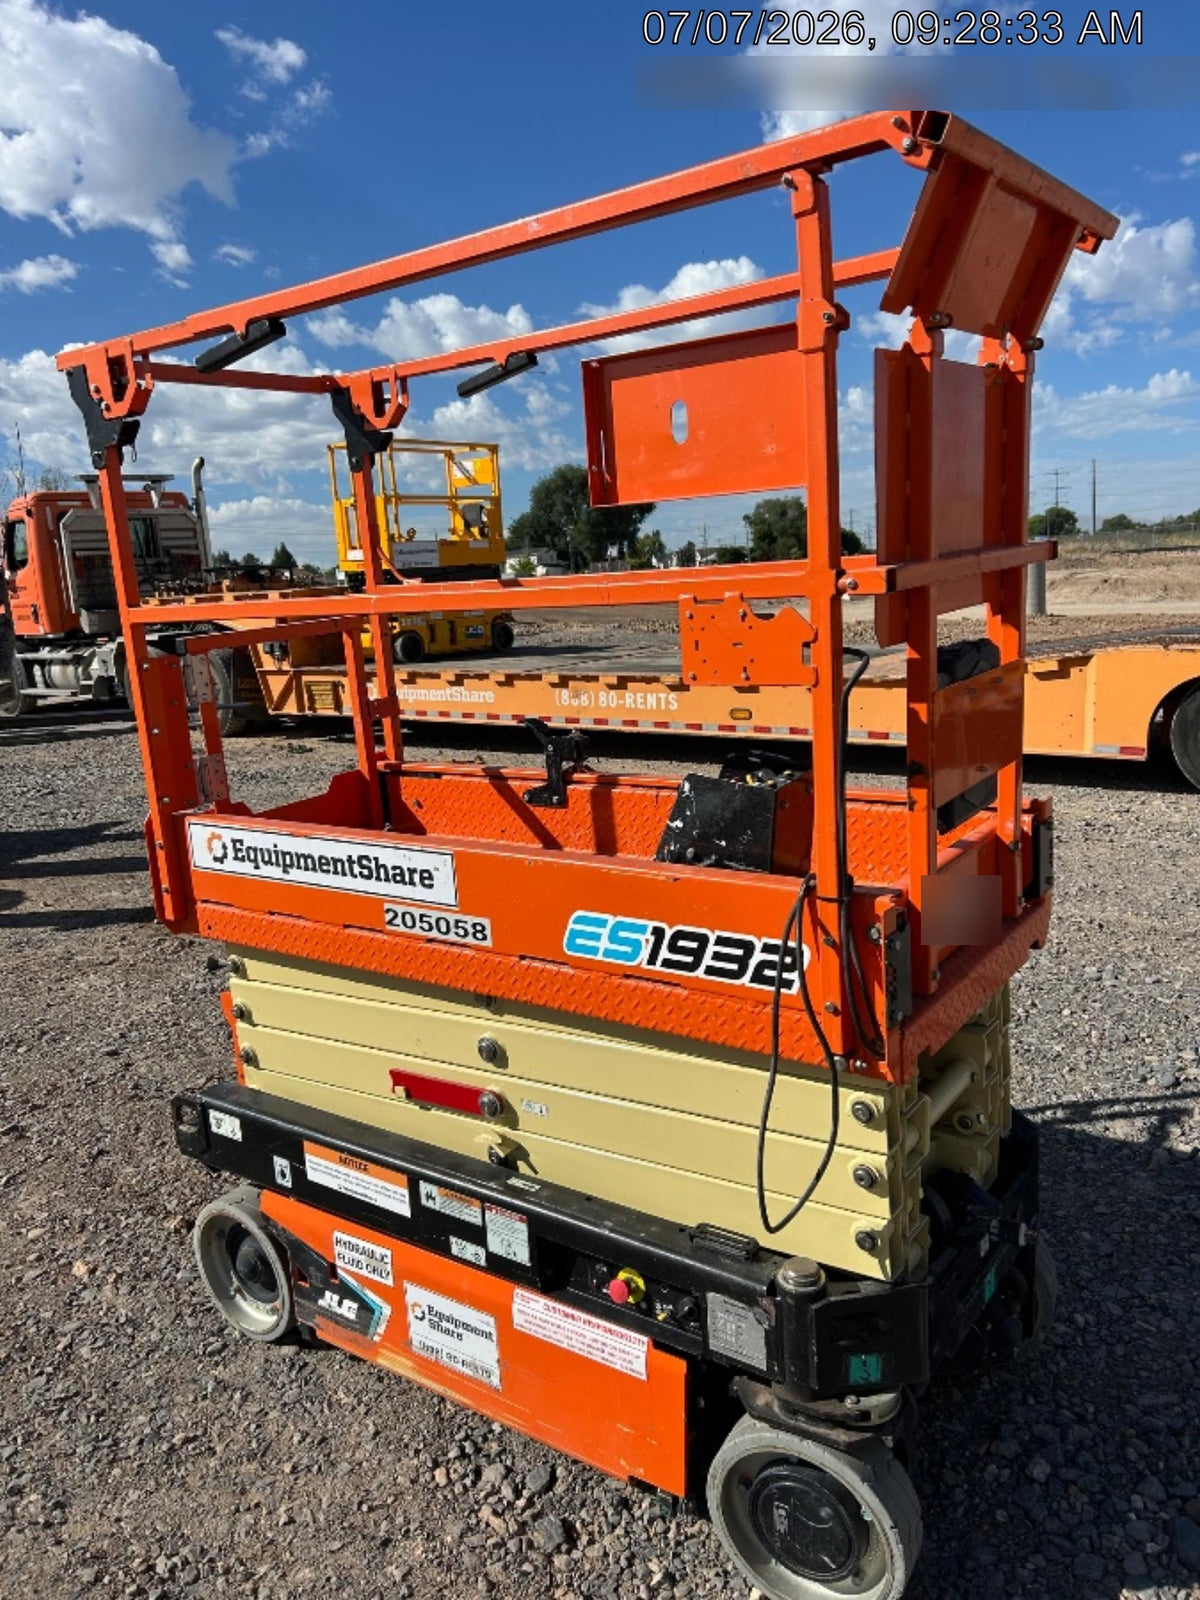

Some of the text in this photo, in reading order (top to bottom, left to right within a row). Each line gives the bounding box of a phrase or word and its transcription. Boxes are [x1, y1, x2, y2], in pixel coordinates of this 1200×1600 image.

[396, 686, 494, 703] uipmentShare
[598, 690, 679, 710] 80-RENTS
[231, 838, 435, 890] EquipmentShare
[385, 907, 489, 942] 205058
[564, 913, 806, 992] ES1932
[337, 1252, 365, 1271] FLUID
[427, 1304, 495, 1343] Equipment
[428, 1319, 464, 1342] Share
